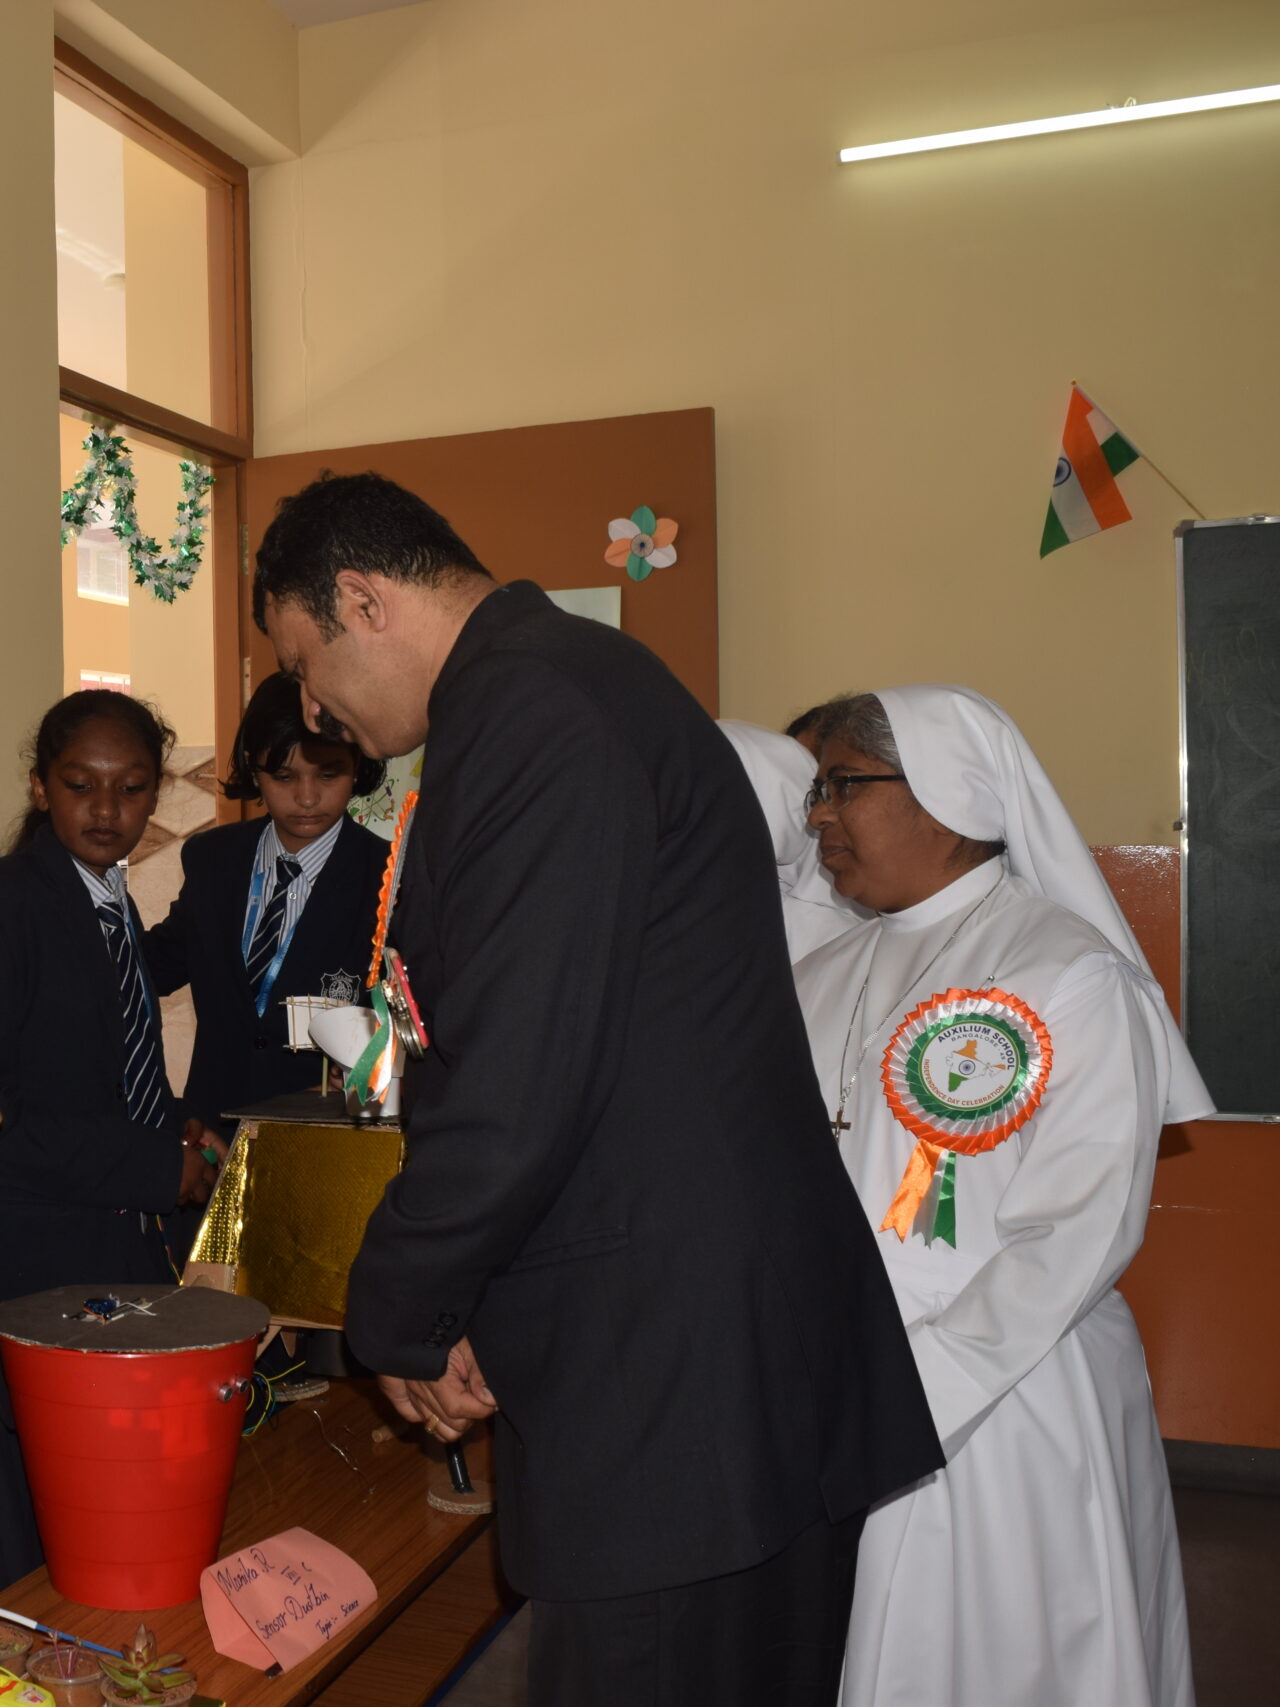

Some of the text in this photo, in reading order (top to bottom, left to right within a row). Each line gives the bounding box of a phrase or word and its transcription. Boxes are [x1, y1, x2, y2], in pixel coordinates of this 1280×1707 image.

[937, 1025, 1015, 1070] AUXILIUM SCHOOL
[951, 1033, 998, 1048] BANGALORE
[923, 1058, 1006, 1106] INDEPENDENCE DAY CELEBRATION
